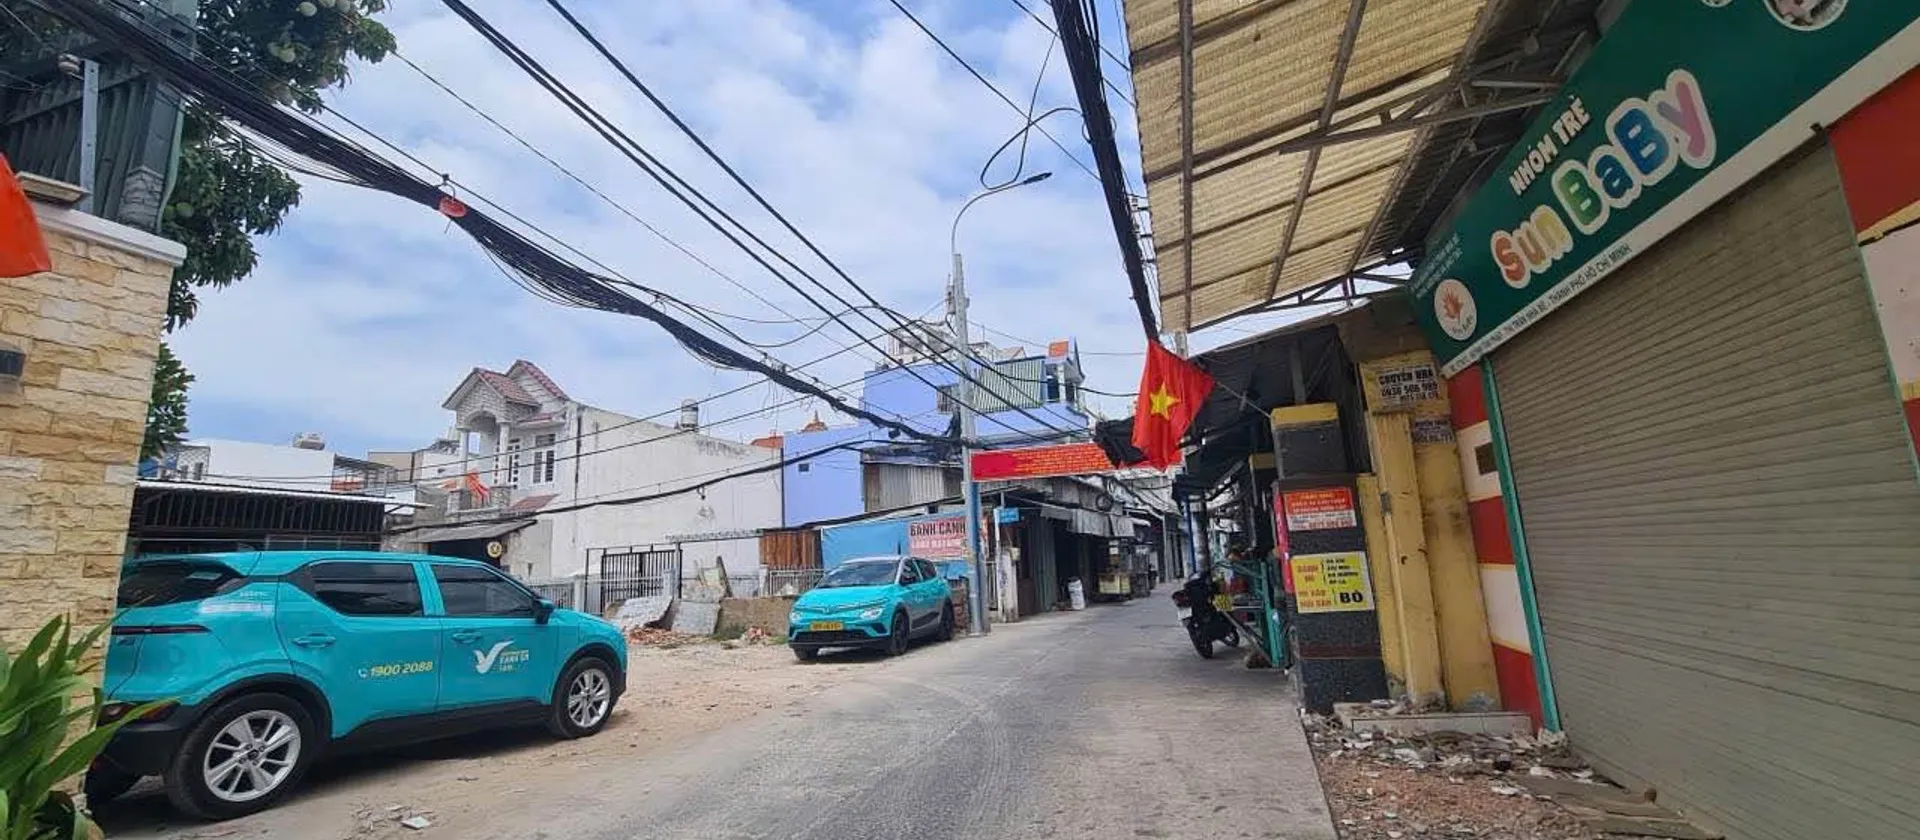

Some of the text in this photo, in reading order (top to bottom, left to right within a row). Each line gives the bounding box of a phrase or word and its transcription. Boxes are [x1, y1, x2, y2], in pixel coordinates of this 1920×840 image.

[1509, 144, 1558, 196] NHÓM
[1492, 206, 1573, 287] Sun
[1339, 589, 1364, 604] BÒ
[370, 660, 434, 679] 1900 2088
